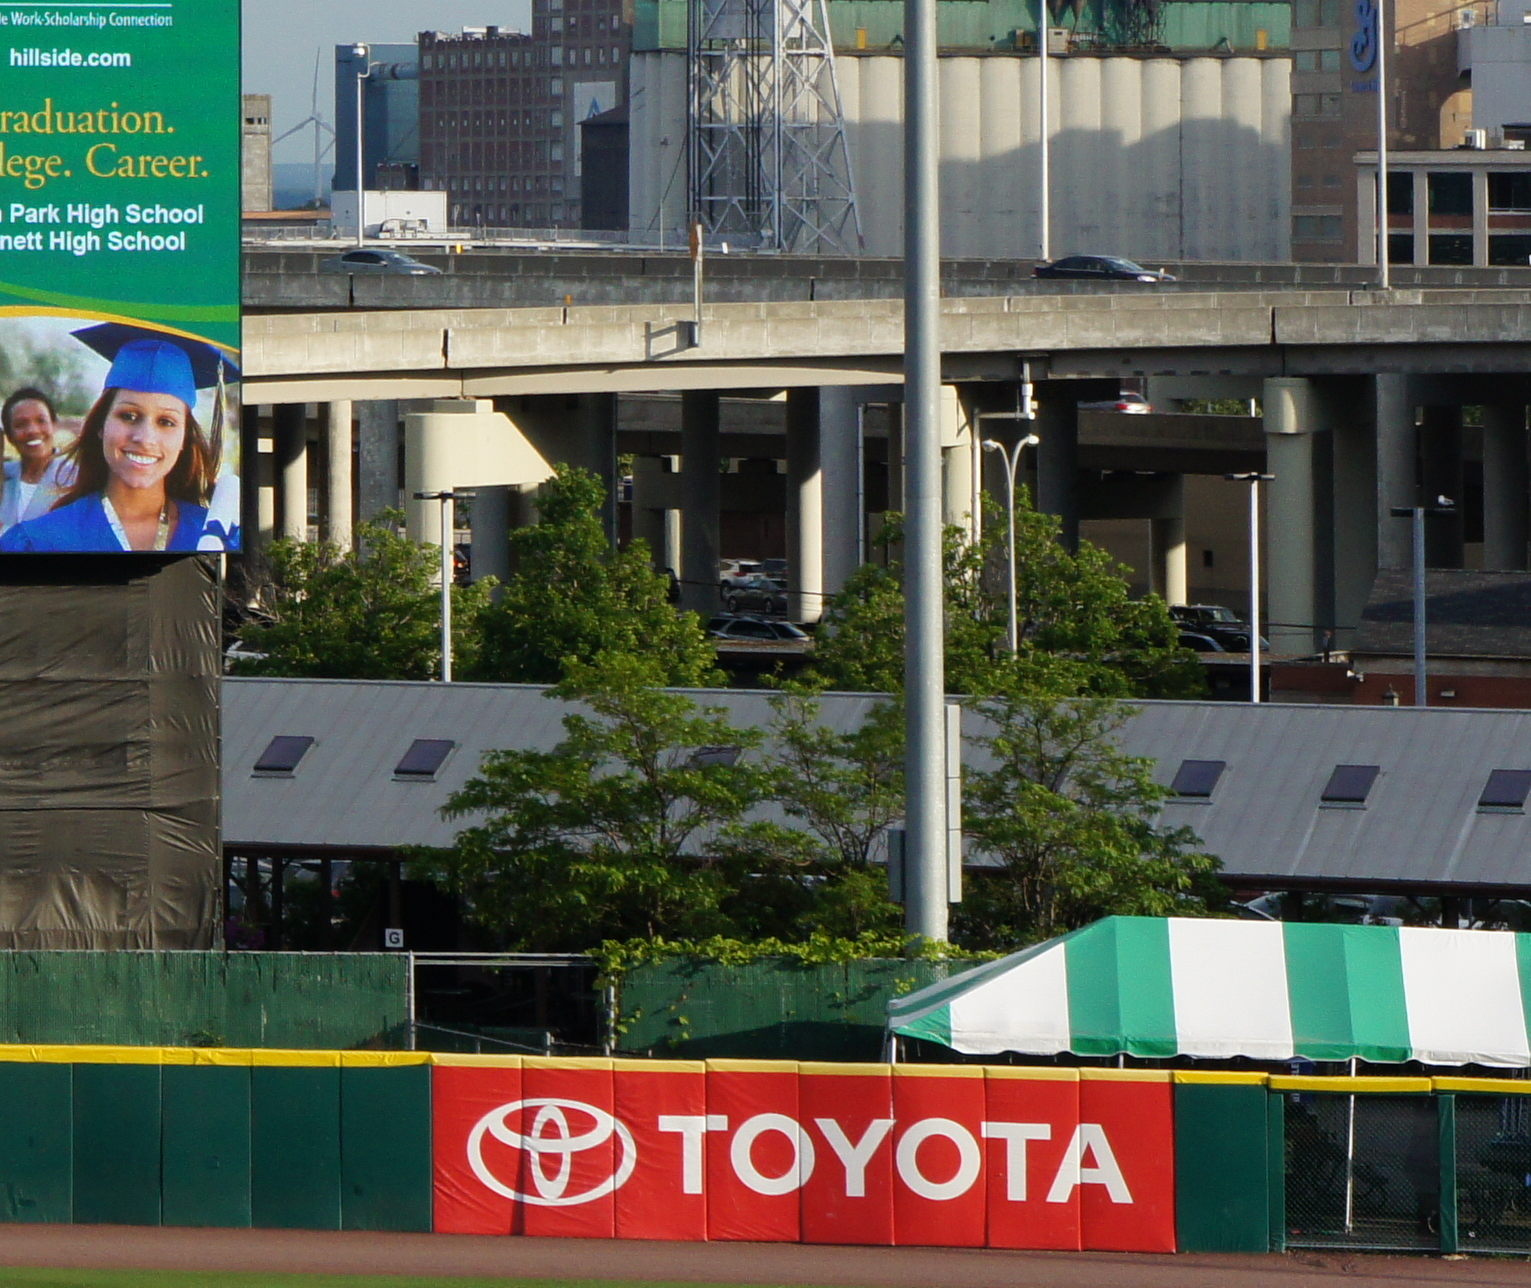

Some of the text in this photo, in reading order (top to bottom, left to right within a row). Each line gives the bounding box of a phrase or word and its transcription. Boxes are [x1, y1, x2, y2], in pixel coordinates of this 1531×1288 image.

[11, 11, 106, 29] Work-Scholarship
[109, 12, 173, 27] Connection
[10, 48, 131, 67] hillside.com
[86, 143, 209, 178] Career.
[10, 204, 60, 224] Park
[67, 204, 120, 229] High
[125, 204, 204, 224] School
[49, 231, 101, 255] High
[108, 231, 186, 251] School
[389, 931, 400, 944] G
[658, 1112, 1133, 1205] TOYOTA
